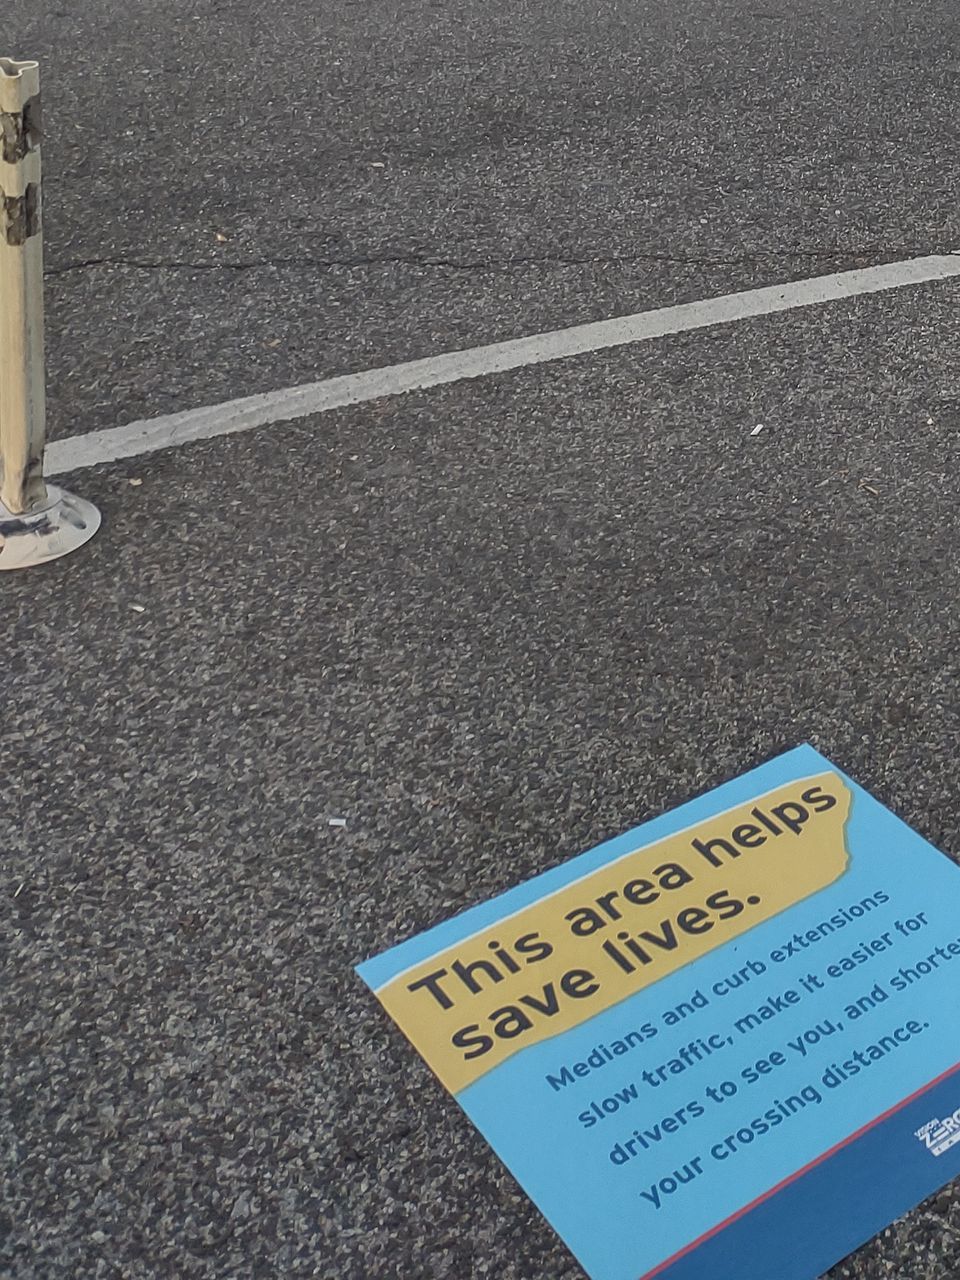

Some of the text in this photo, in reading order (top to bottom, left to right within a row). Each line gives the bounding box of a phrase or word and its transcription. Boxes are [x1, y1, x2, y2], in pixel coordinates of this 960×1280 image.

[407, 787, 836, 1010] This area helps
[452, 890, 760, 1060] save lives.
[546, 891, 889, 1091] Medians and curb extensions
[579, 913, 927, 1128] slow traffic, make it easier for
[610, 1101, 704, 1165] drivers
[706, 1082, 737, 1102] to
[741, 1052, 786, 1083] see
[787, 1020, 843, 1056] you,
[844, 984, 888, 1019] and
[640, 1021, 929, 1209] your crossing distance.
[914, 1118, 940, 1137] VISION
